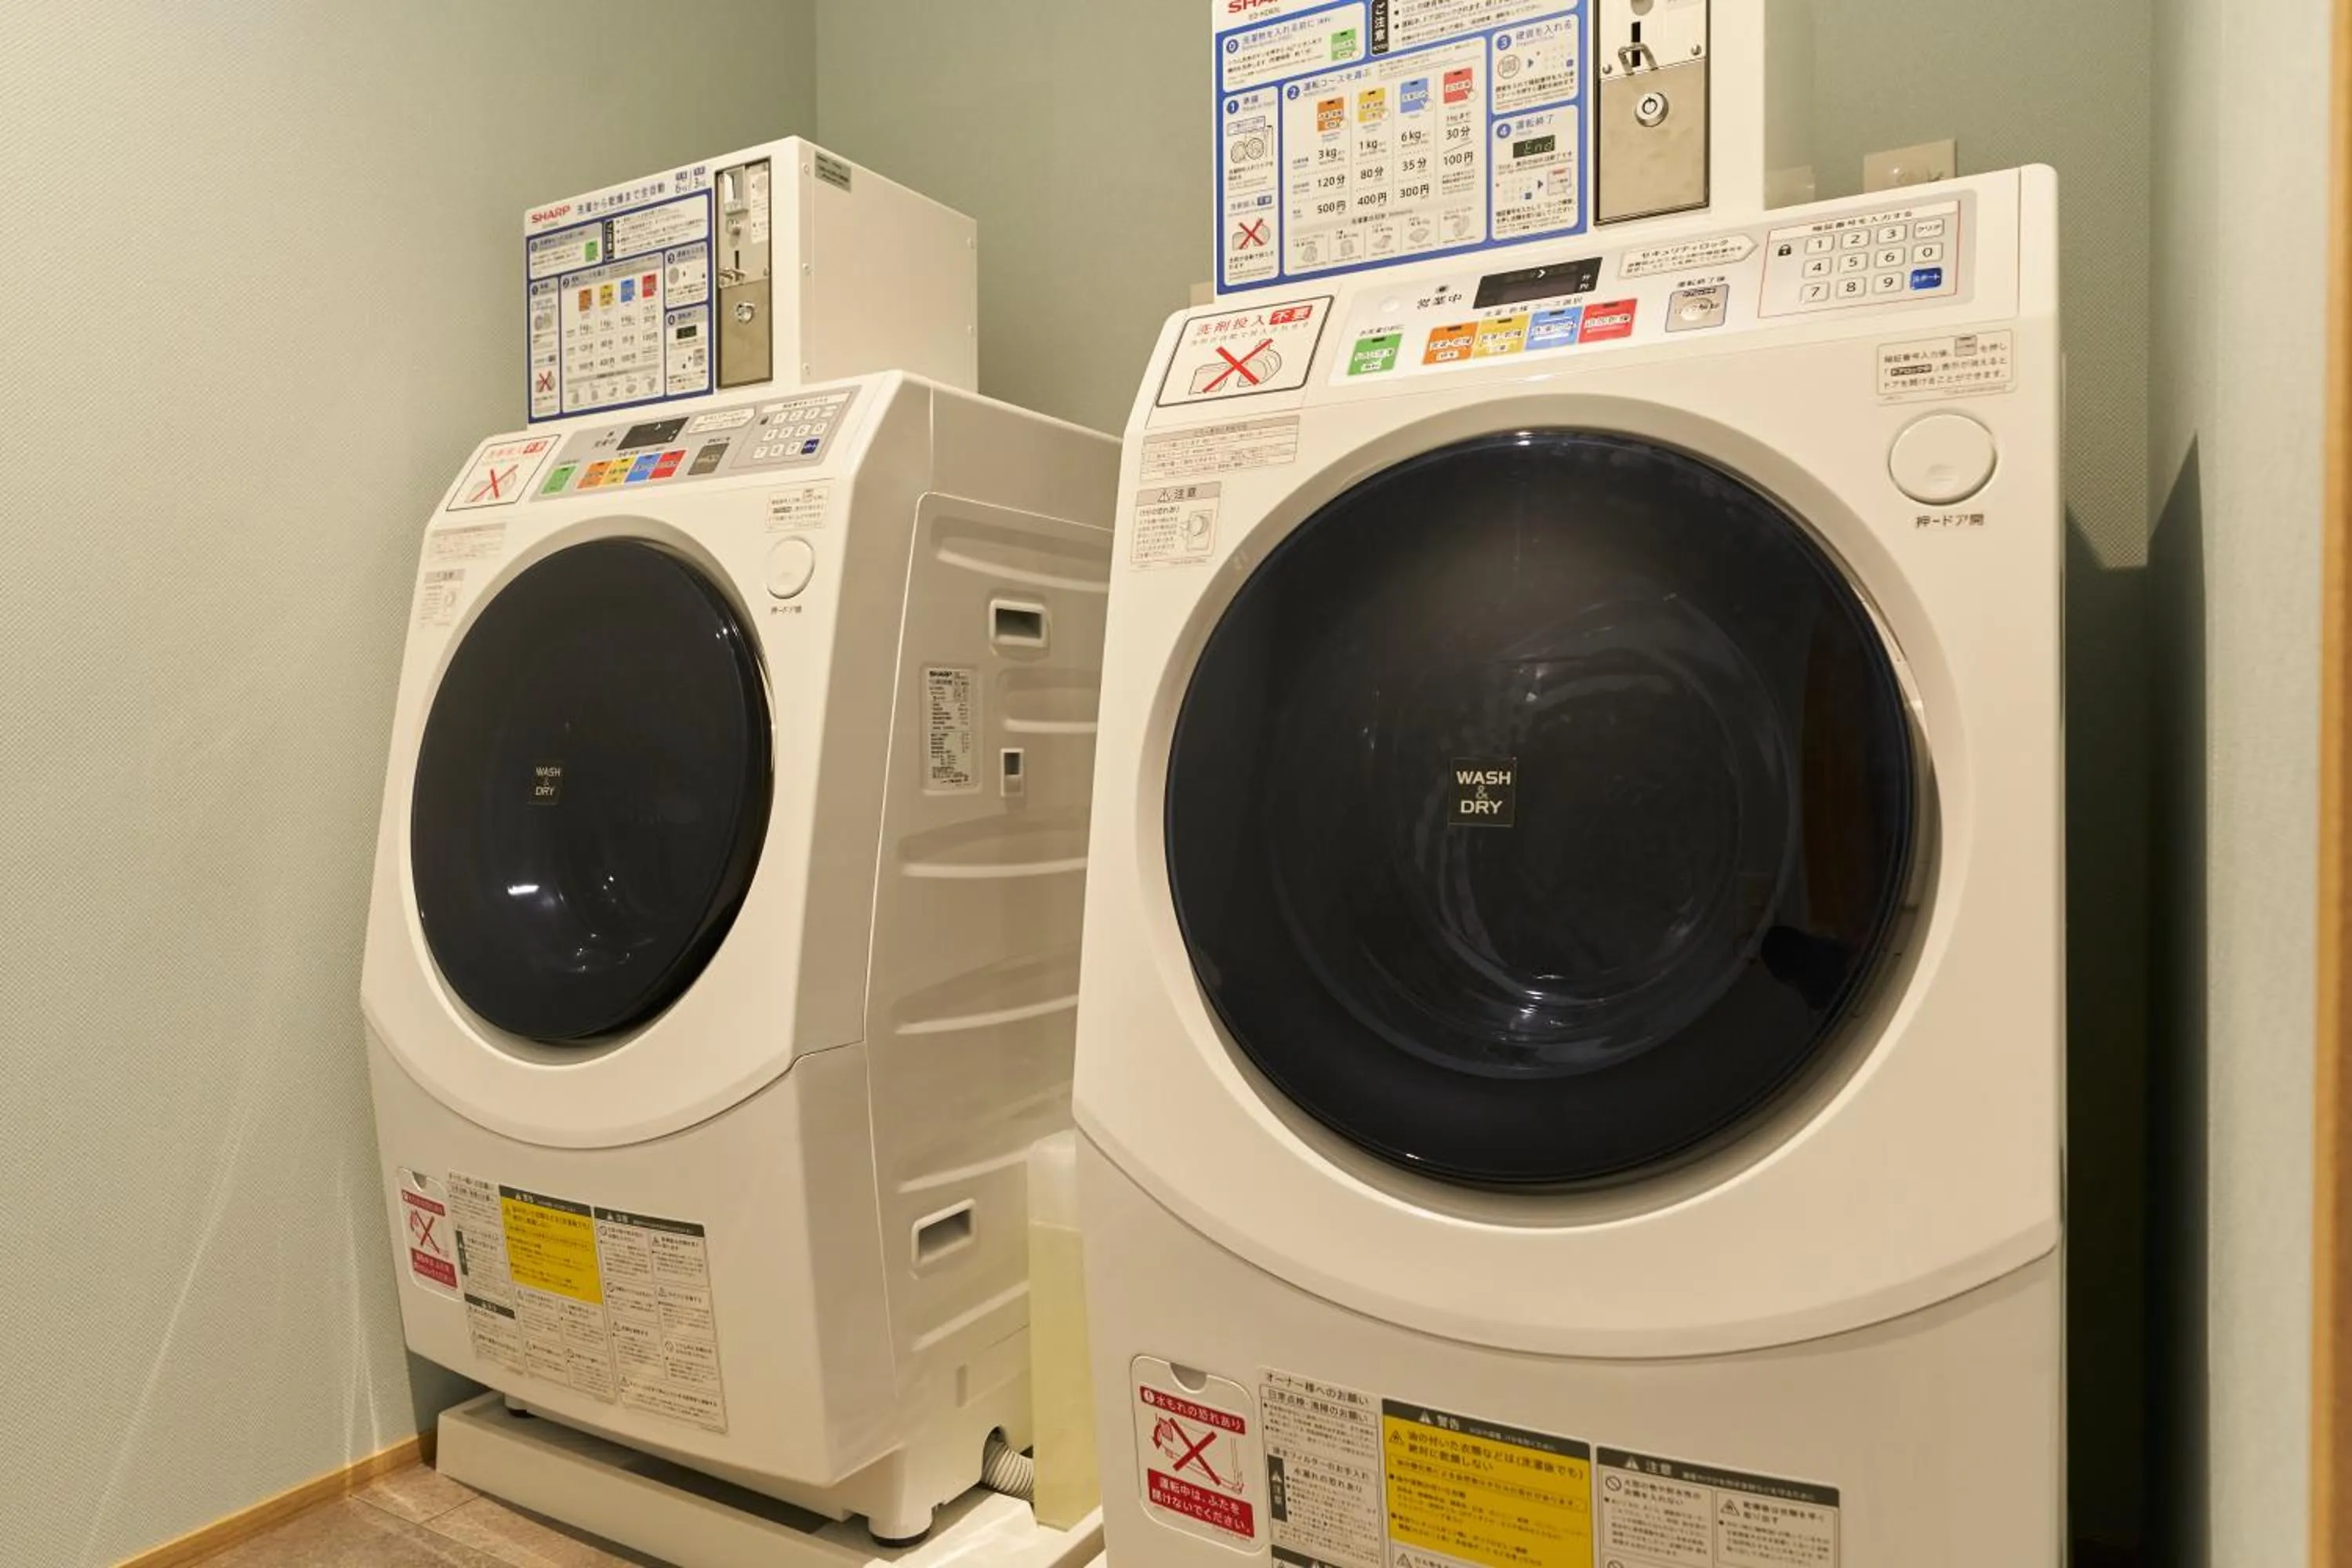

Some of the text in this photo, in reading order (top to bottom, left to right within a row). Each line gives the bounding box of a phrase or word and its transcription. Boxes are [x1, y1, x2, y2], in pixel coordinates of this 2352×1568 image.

[1443, 151, 1473, 165] 100円
[1402, 157, 1426, 172] 35分
[1360, 166, 1384, 179] 80分
[1317, 174, 1345, 188] 120分
[1399, 183, 1429, 198] 300円
[1358, 192, 1387, 205] 400円
[1317, 200, 1346, 214] 500円
[532, 205, 571, 223] SHARP
[1850, 234, 1860, 244] 2
[1886, 229, 1896, 238] 3
[1817, 240, 1822, 249] 1
[1885, 252, 1895, 263] 6
[1922, 247, 1933, 258] 0
[1812, 263, 1822, 272] 4
[1849, 257, 1858, 267] 5
[1846, 282, 1857, 292] 8
[1883, 277, 1893, 288] 9
[1812, 287, 1820, 297] 7
[535, 766, 561, 777] WASH
[1456, 771, 1511, 785] WASH
[535, 786, 554, 796] DRY
[1475, 785, 1489, 800] &
[1461, 800, 1503, 815] DRY
[1156, 1396, 1242, 1431] 水もれの恐れあり
